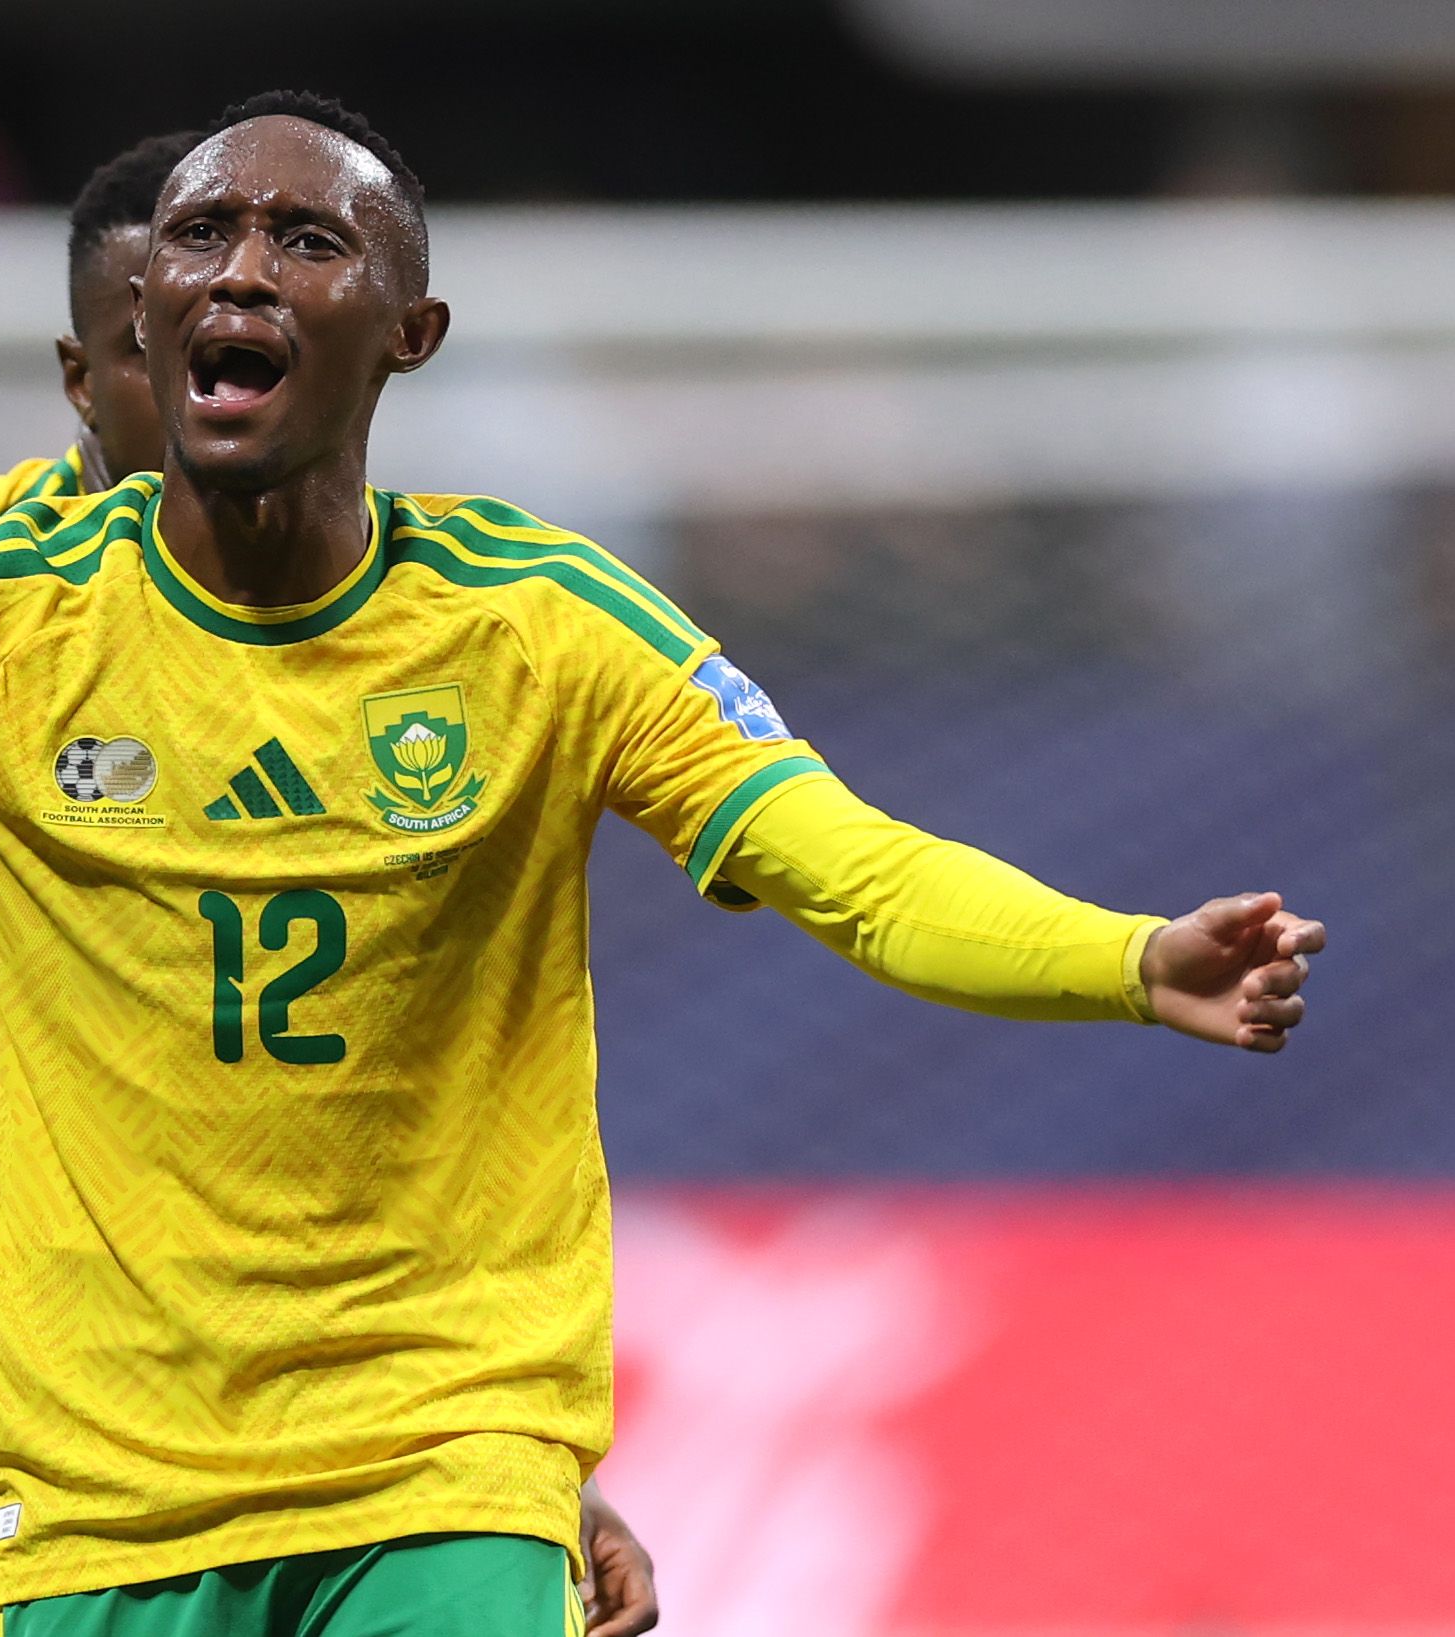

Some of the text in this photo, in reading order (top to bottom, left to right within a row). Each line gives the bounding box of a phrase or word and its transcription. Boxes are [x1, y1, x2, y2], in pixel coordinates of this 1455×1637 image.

[42, 812, 165, 825] FOOTBALL ASSOCIATION
[64, 805, 145, 815] SOUTH AFRICAN
[388, 804, 472, 830] SOUTH AFRICA
[198, 889, 347, 1064] 12
